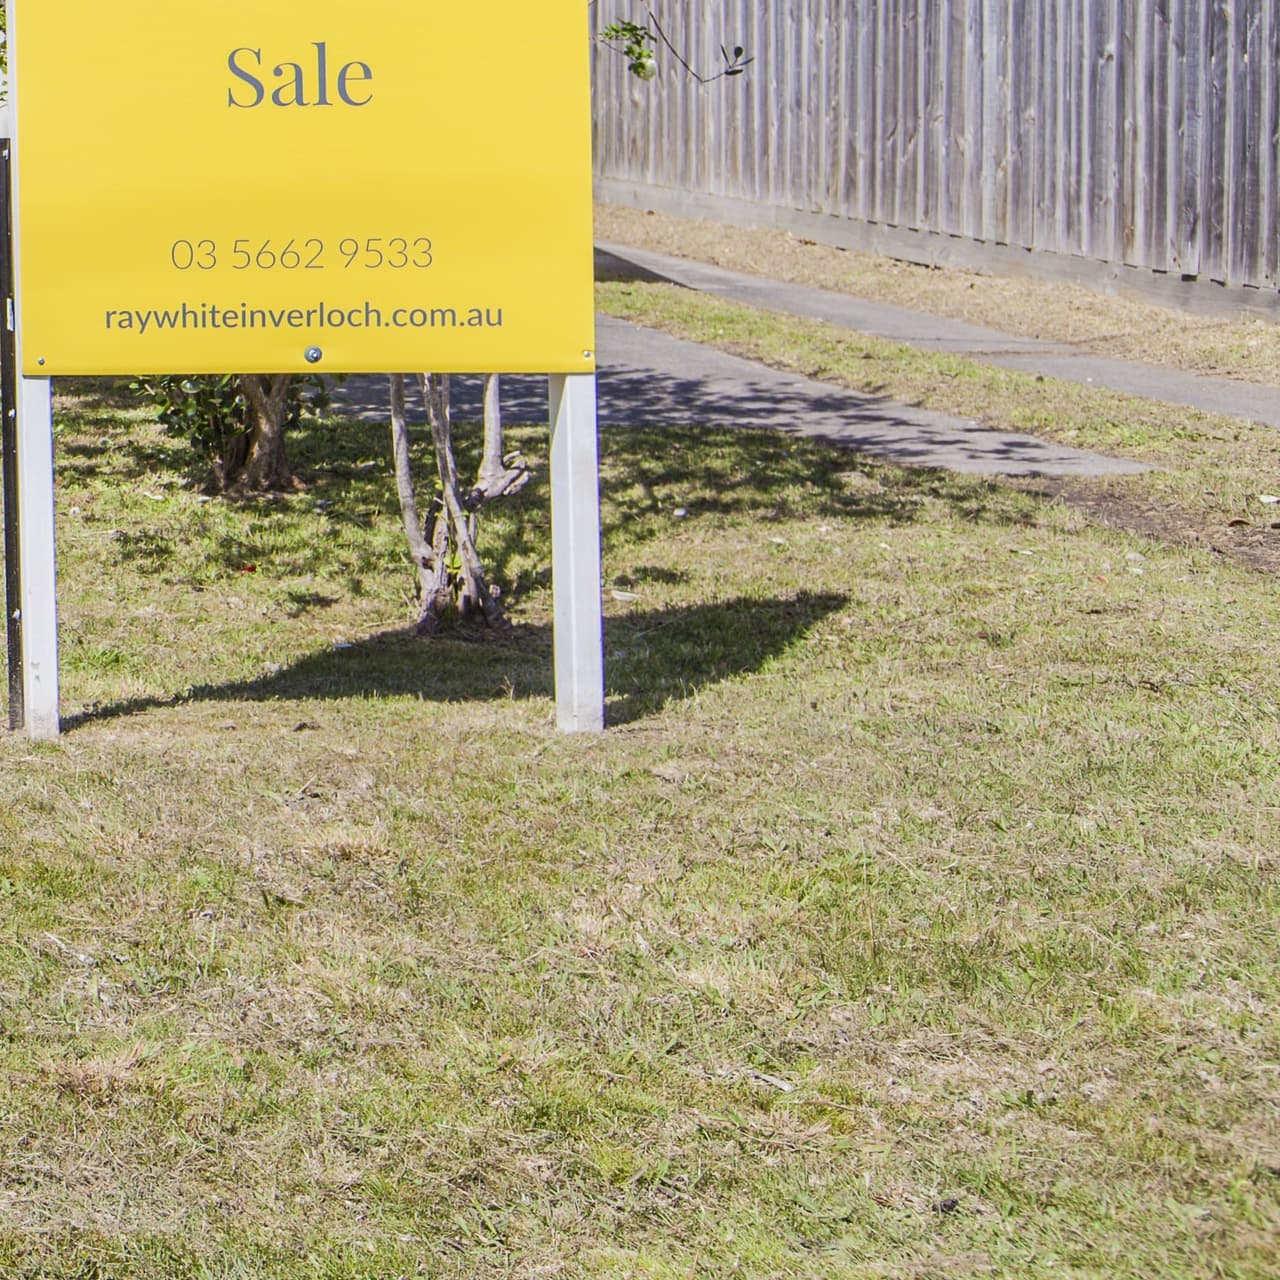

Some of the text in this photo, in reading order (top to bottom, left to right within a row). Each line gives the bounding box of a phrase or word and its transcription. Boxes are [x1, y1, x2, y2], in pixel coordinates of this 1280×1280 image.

[227, 41, 373, 109] Sale
[171, 236, 434, 270] 03 5662 9533
[105, 300, 504, 335] raywhiteinverloch.com.au
